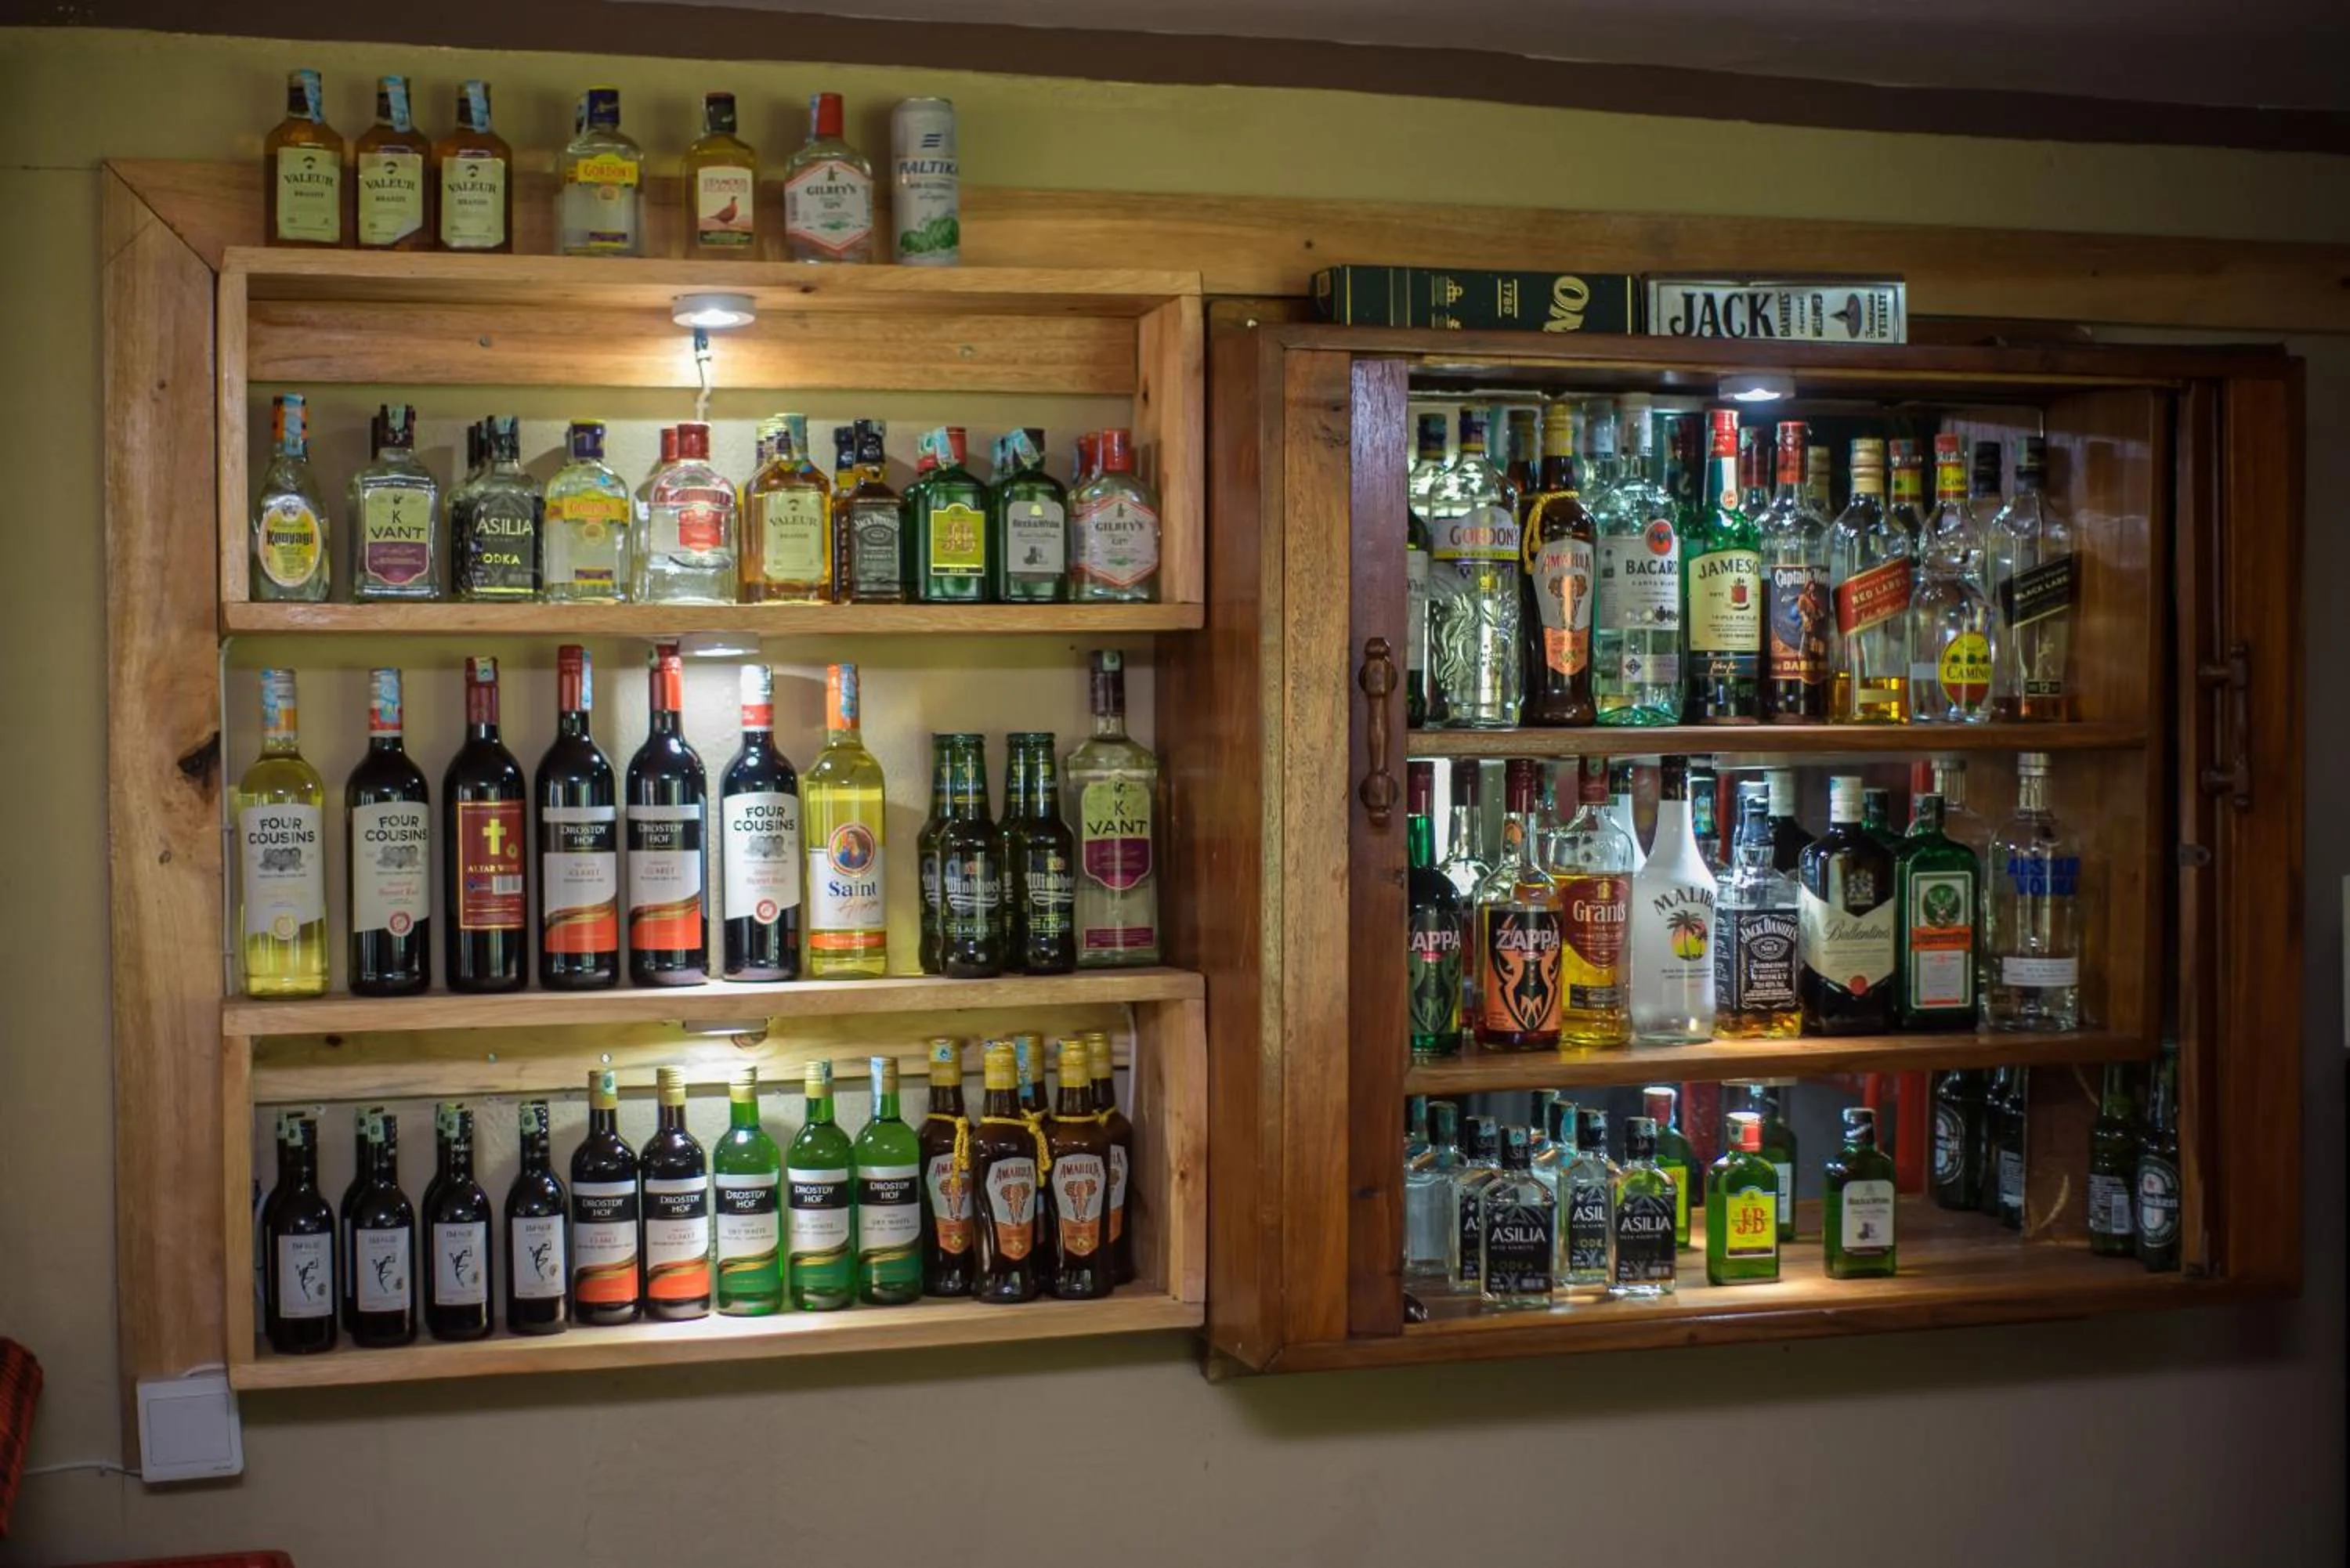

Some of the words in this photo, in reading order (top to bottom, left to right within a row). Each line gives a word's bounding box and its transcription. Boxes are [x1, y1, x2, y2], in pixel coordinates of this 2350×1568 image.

[284, 173, 334, 188] VALEUR
[365, 177, 415, 192] VALEUR
[447, 181, 497, 194] VALEUR
[806, 183, 857, 196] GILBEY'S
[1502, 282, 1513, 314] 1780
[1668, 291, 1775, 338] JACK
[392, 510, 402, 523] K
[769, 515, 818, 527] VALEUR
[370, 526, 425, 540] VANT
[476, 518, 534, 536] ASILIA
[1095, 521, 1144, 532] GILBEY'S
[1449, 524, 1518, 547] GORDON'S
[1542, 551, 1591, 576] AMARULA
[1625, 559, 1678, 576] BACAR
[1697, 556, 1759, 580] JAMESO
[1775, 568, 1810, 584] Captain
[1851, 591, 1875, 606] RED
[1877, 576, 1911, 598] LABEL
[2014, 584, 2041, 600] BLACK
[1946, 664, 1990, 681] CAMINO
[2038, 682, 2052, 694] 12
[745, 806, 786, 818] FOUR
[1114, 800, 1125, 816] K
[259, 817, 302, 831] FOUR
[378, 815, 419, 829] FOUR
[638, 823, 684, 833] DROSTDY
[733, 818, 795, 832] COUSINS
[1086, 820, 1147, 835] VANT
[248, 830, 315, 844] COUSINS
[365, 829, 428, 843] COUSINS
[560, 825, 606, 836] DROSTDY
[573, 835, 596, 845] HOF
[649, 834, 671, 844] HOF
[828, 880, 877, 898] Saint
[957, 924, 990, 935] LAGER
[1739, 920, 1762, 943] JACK
[1763, 916, 1799, 939] DANIEL'S
[1408, 930, 1461, 952] APPA
[1495, 929, 1560, 951] ZAPPA
[1060, 1162, 1101, 1179] AMARULA
[725, 1190, 767, 1201] DROSTDY
[795, 1185, 834, 1196] DROSTDY
[880, 1190, 900, 1200] HOF
[736, 1199, 756, 1209] HOF
[804, 1194, 825, 1204] HOF
[671, 1205, 691, 1214] HOF
[1572, 1205, 1605, 1223] ASIL
[1620, 1216, 1672, 1232] ASILIA
[1736, 1207, 1767, 1235] J&B
[1491, 1227, 1546, 1243] ASILIA
